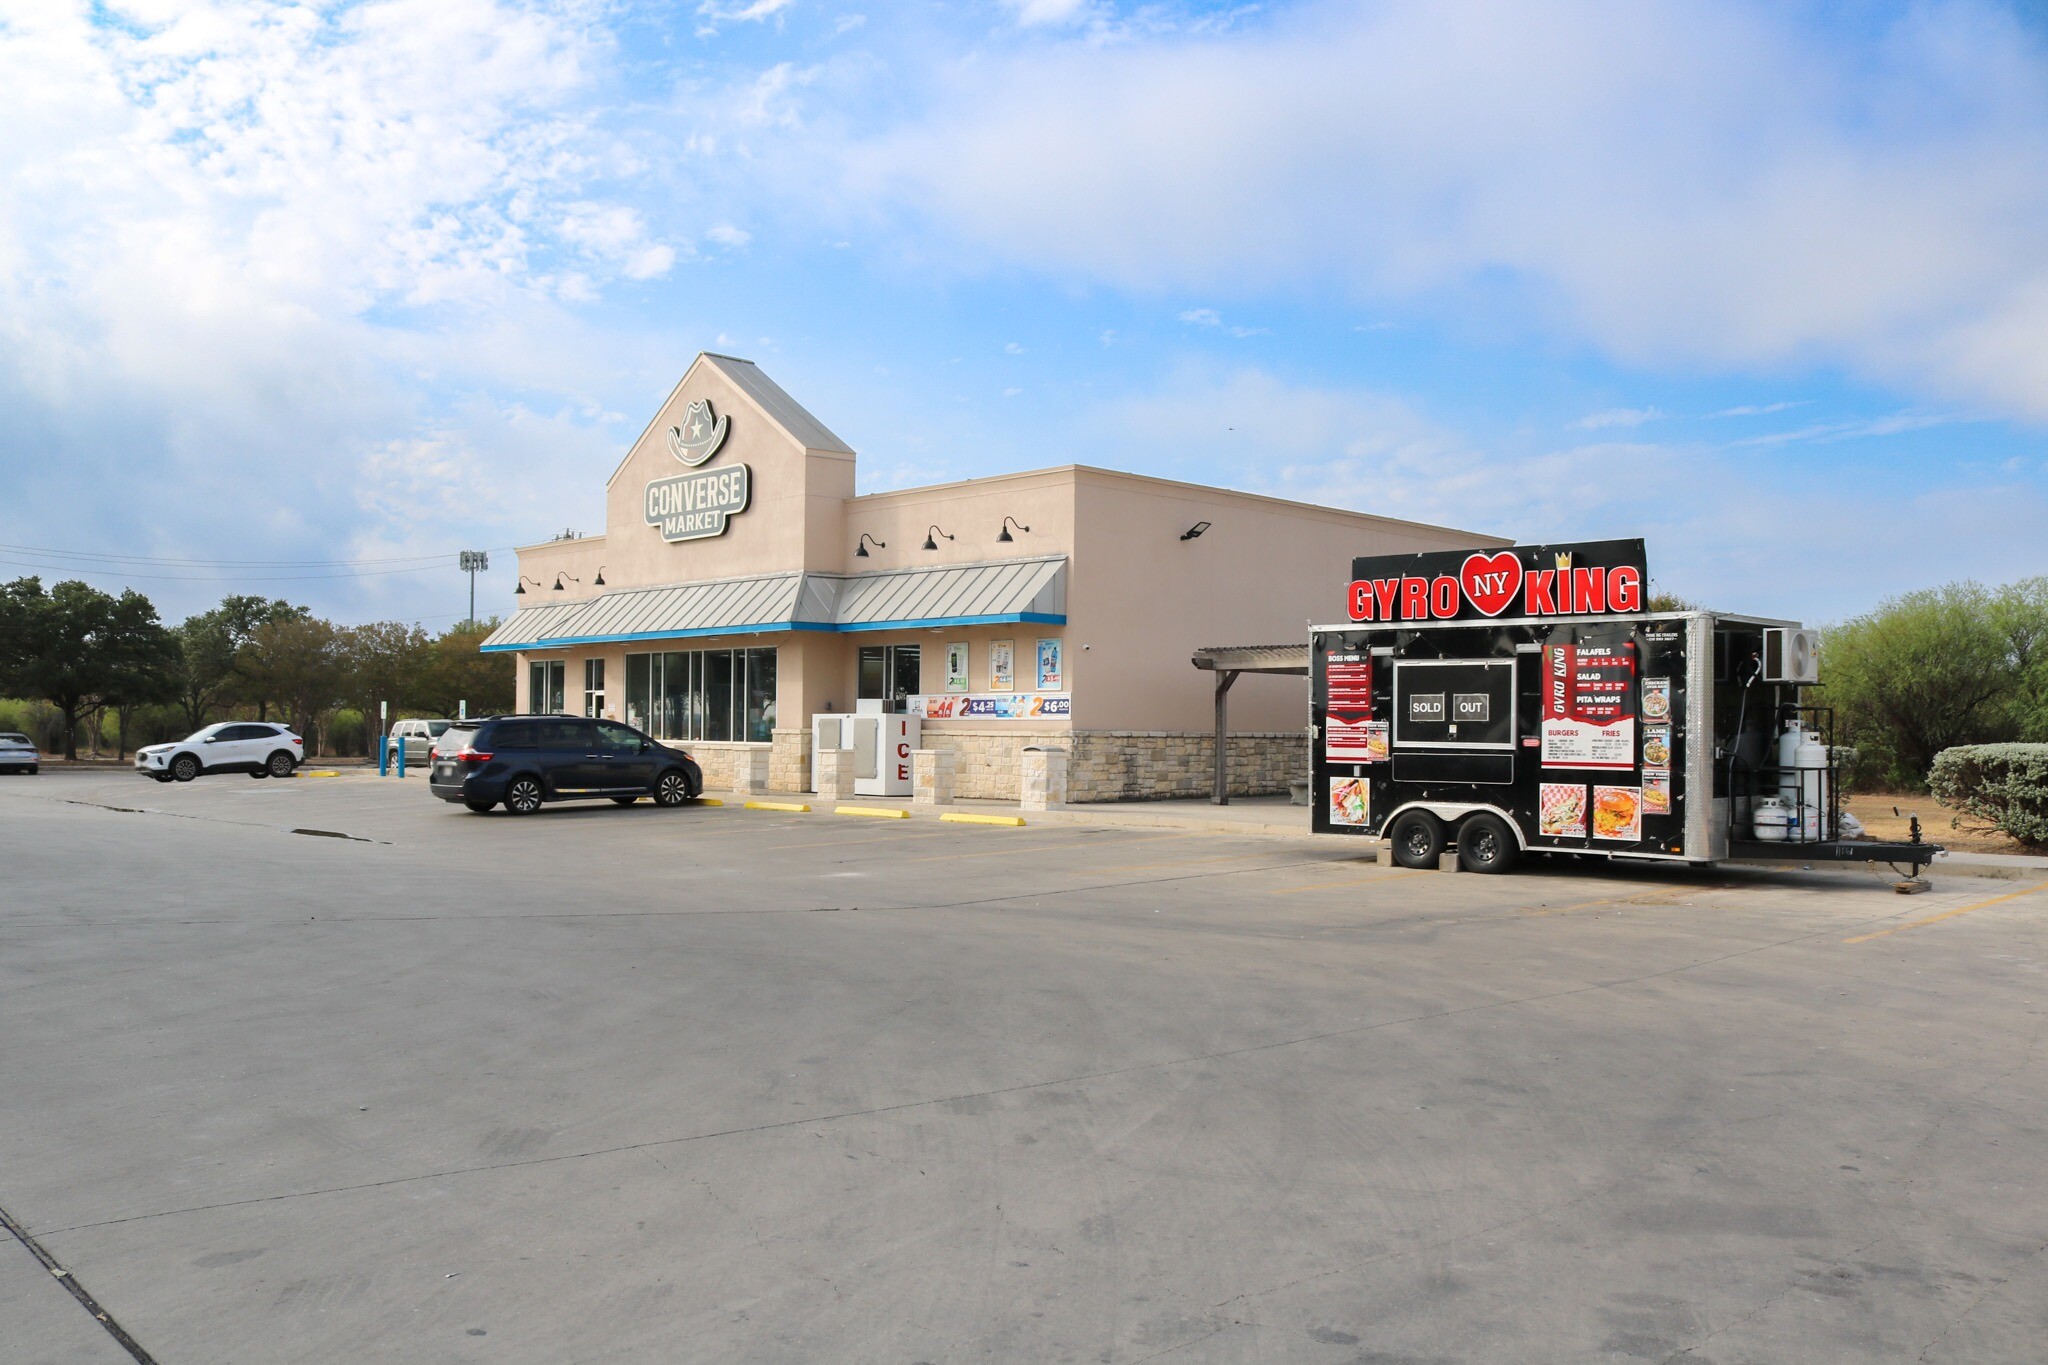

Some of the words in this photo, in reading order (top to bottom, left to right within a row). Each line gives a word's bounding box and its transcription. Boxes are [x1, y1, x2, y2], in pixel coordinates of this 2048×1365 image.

[648, 472, 741, 517] CONVERSE
[665, 510, 721, 535] MARKET
[1347, 575, 1460, 622] GYRO
[1473, 571, 1509, 597] NY
[1524, 565, 1641, 616] KING
[1554, 647, 1567, 678] KING
[1576, 648, 1611, 656] FALAFELS
[959, 697, 971, 716] 2
[972, 701, 995, 713] $4.25
[1030, 696, 1043, 716] 2
[1044, 700, 1069, 713] $6.00
[1412, 702, 1441, 712] SOLD
[1460, 702, 1482, 712] OUT
[1554, 680, 1566, 713] GYRO
[1548, 729, 1579, 737] BURGERS
[897, 720, 910, 781] ICE
